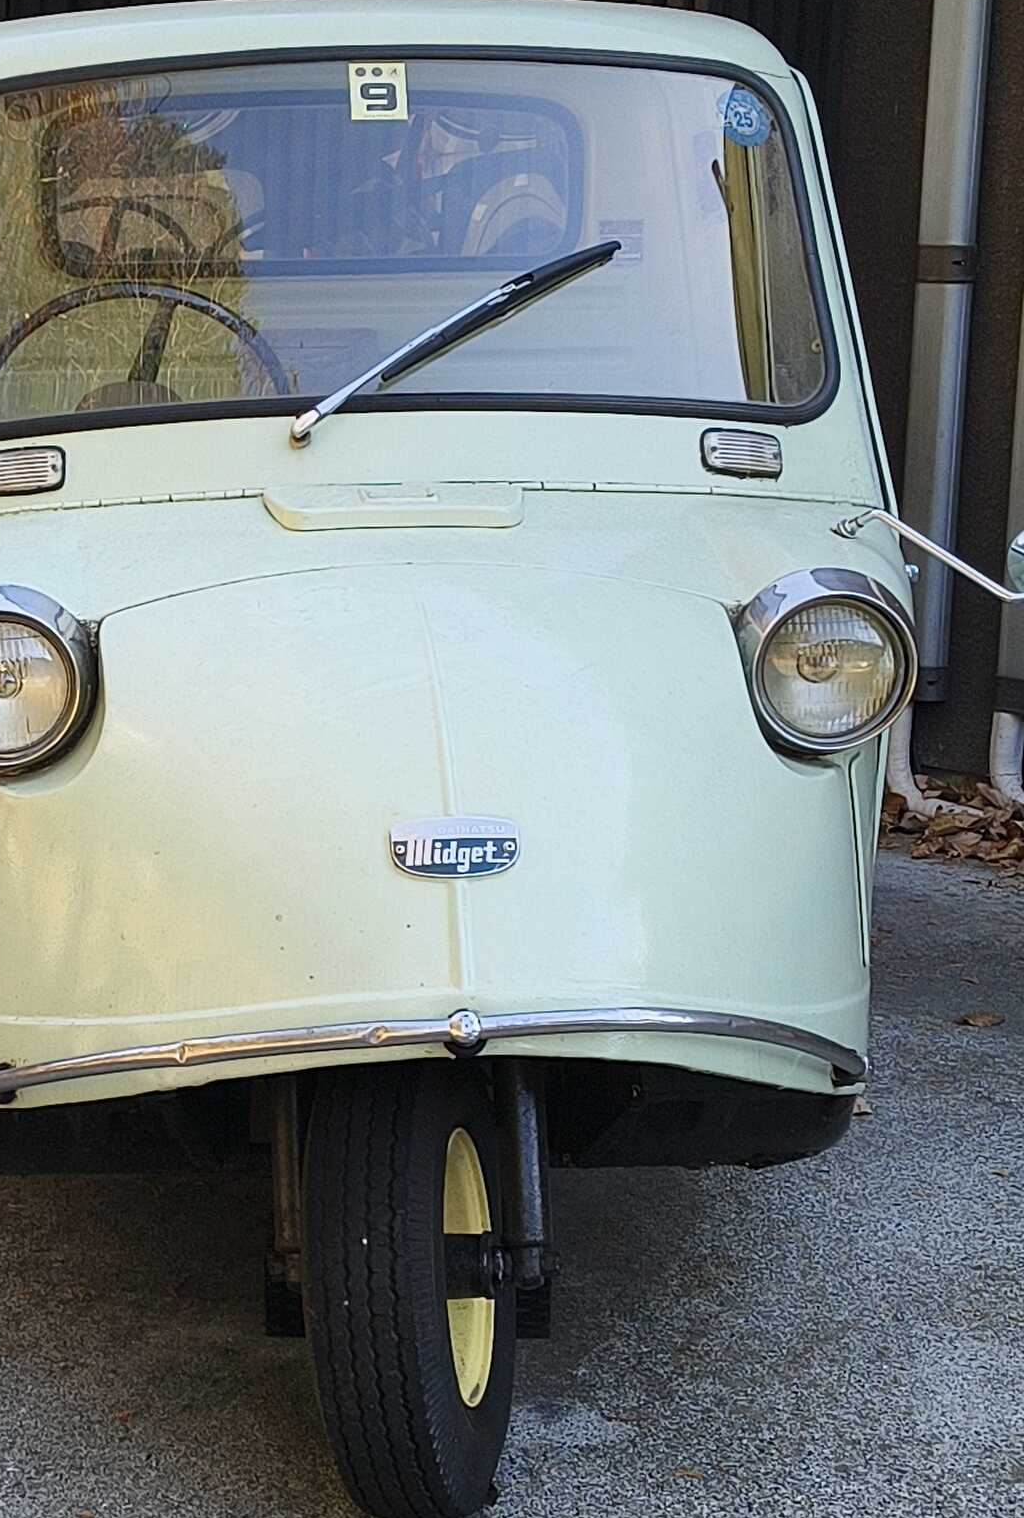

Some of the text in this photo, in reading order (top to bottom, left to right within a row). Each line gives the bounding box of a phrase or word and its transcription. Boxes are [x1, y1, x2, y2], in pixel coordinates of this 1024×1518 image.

[360, 82, 397, 111] 9
[733, 110, 753, 128] 25
[404, 838, 509, 873] Midget
